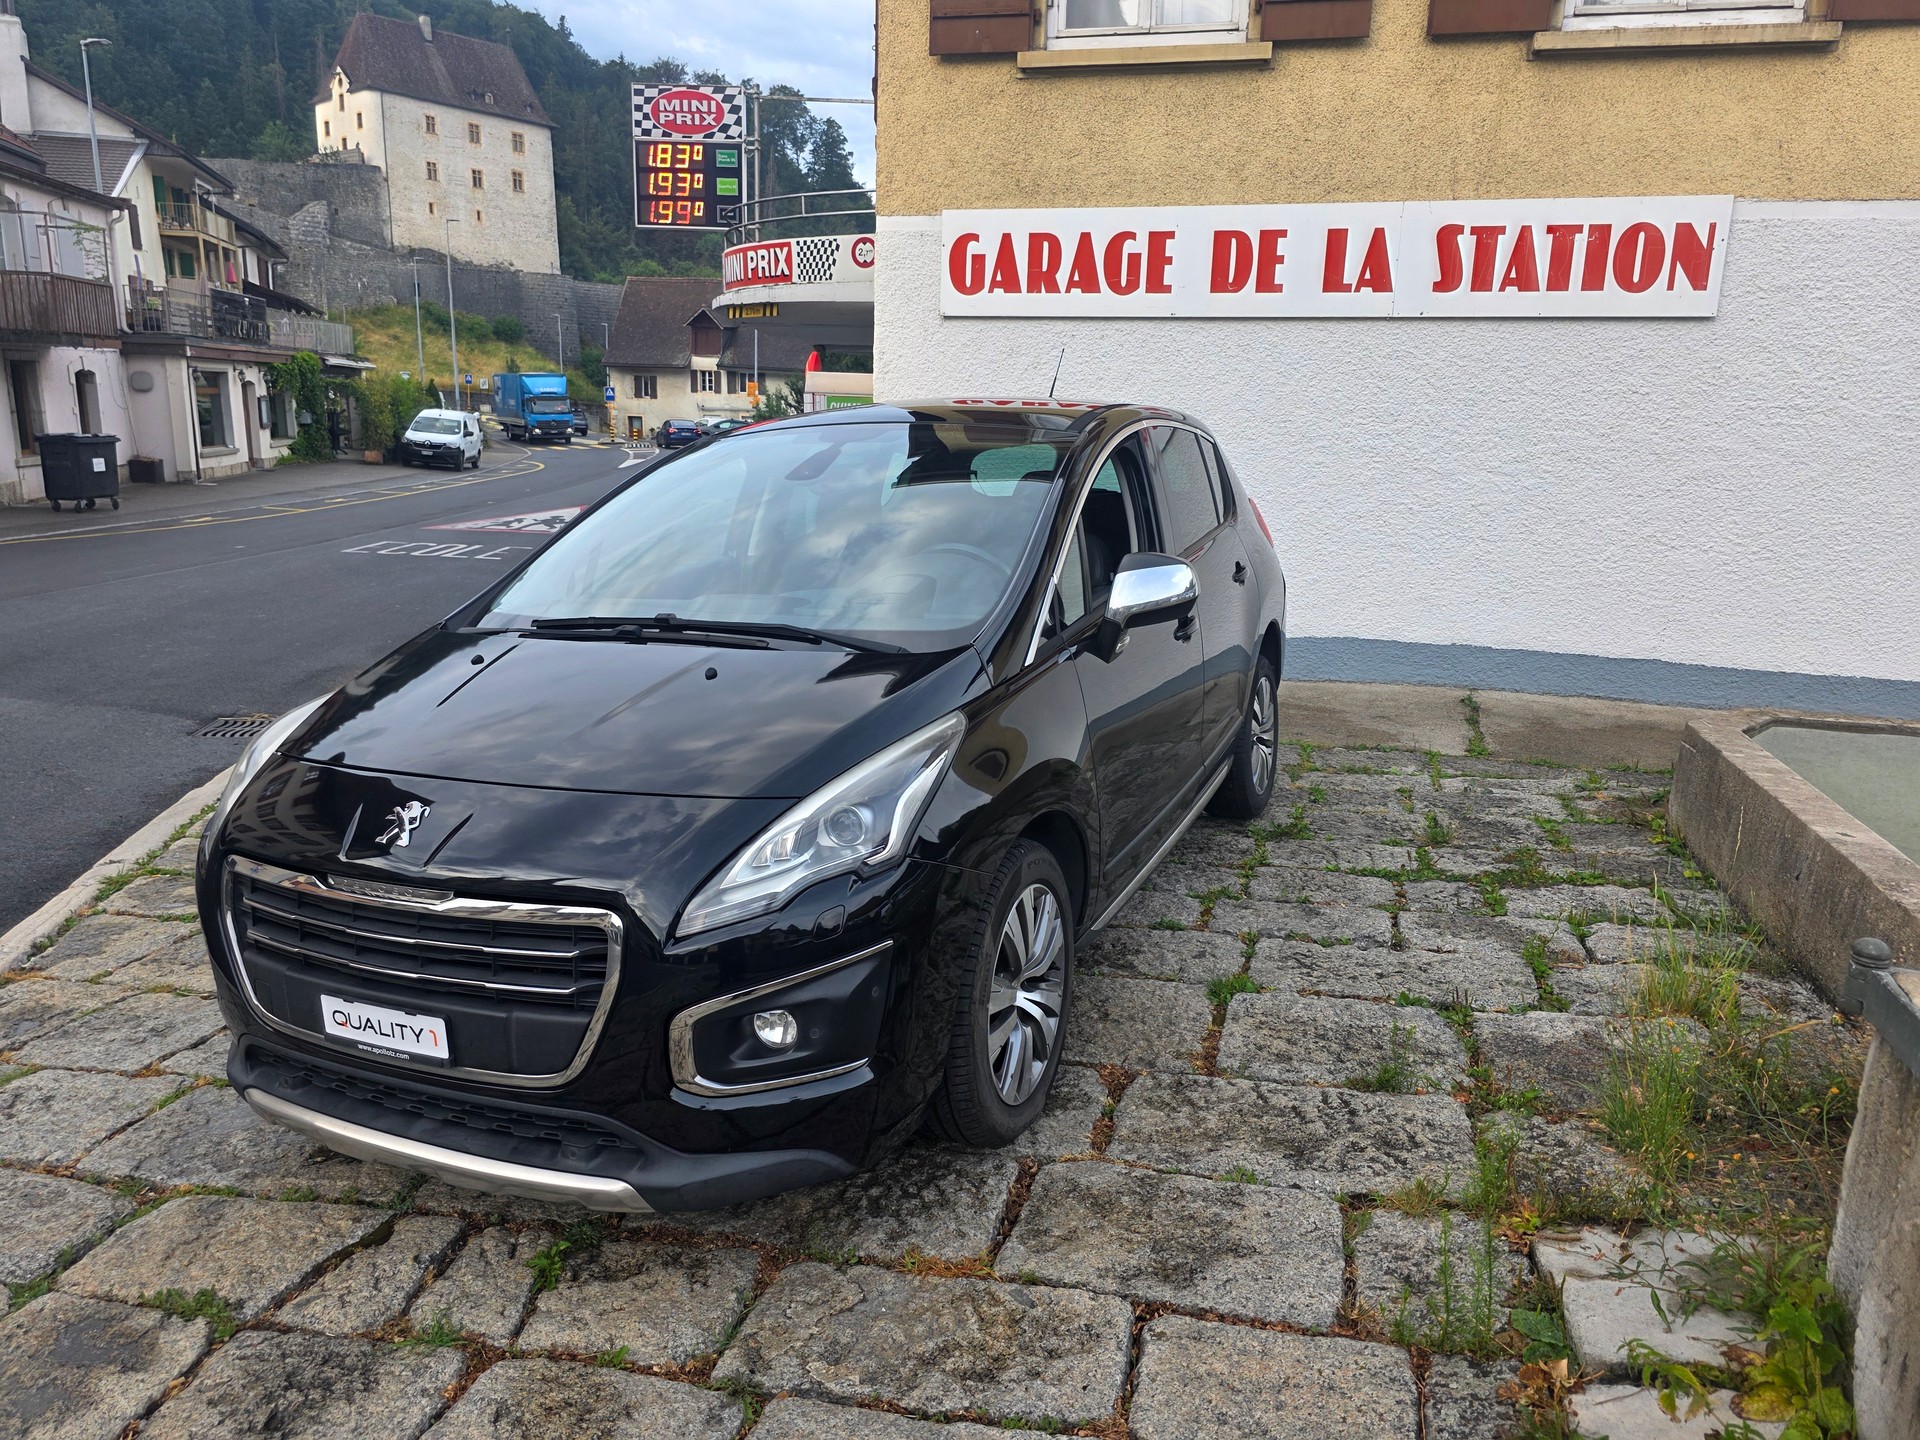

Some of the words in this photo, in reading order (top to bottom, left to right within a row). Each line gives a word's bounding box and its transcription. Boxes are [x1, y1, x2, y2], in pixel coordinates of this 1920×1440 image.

[658, 98, 717, 113] MINI
[658, 112, 718, 127] PRIX
[724, 252, 745, 284] MINI
[746, 246, 791, 280] PRIX
[948, 230, 1176, 296] GARAGE
[1210, 229, 1288, 294] DE
[1322, 227, 1393, 294] LA
[1432, 221, 1717, 294] STATION
[340, 541, 533, 560] ECOLE
[332, 1009, 424, 1044] QUALITY
